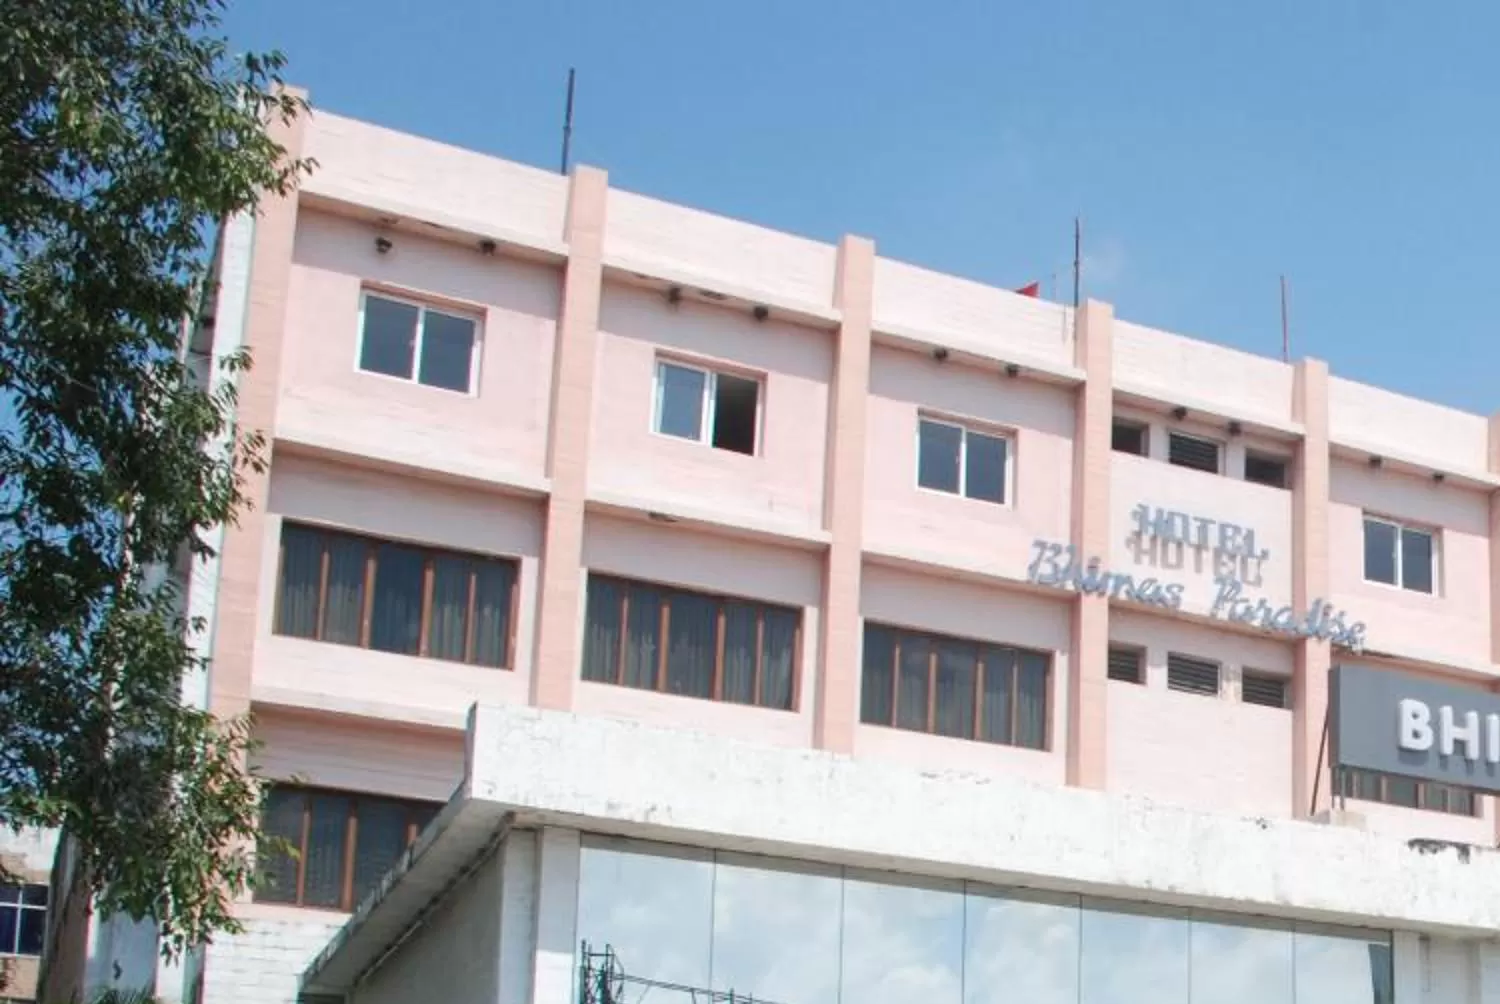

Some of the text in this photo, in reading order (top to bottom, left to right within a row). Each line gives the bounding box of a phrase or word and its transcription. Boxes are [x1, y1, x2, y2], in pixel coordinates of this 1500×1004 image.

[1131, 503, 1269, 559] HOTEL
[1028, 539, 1367, 650] Bhimas Paradise
